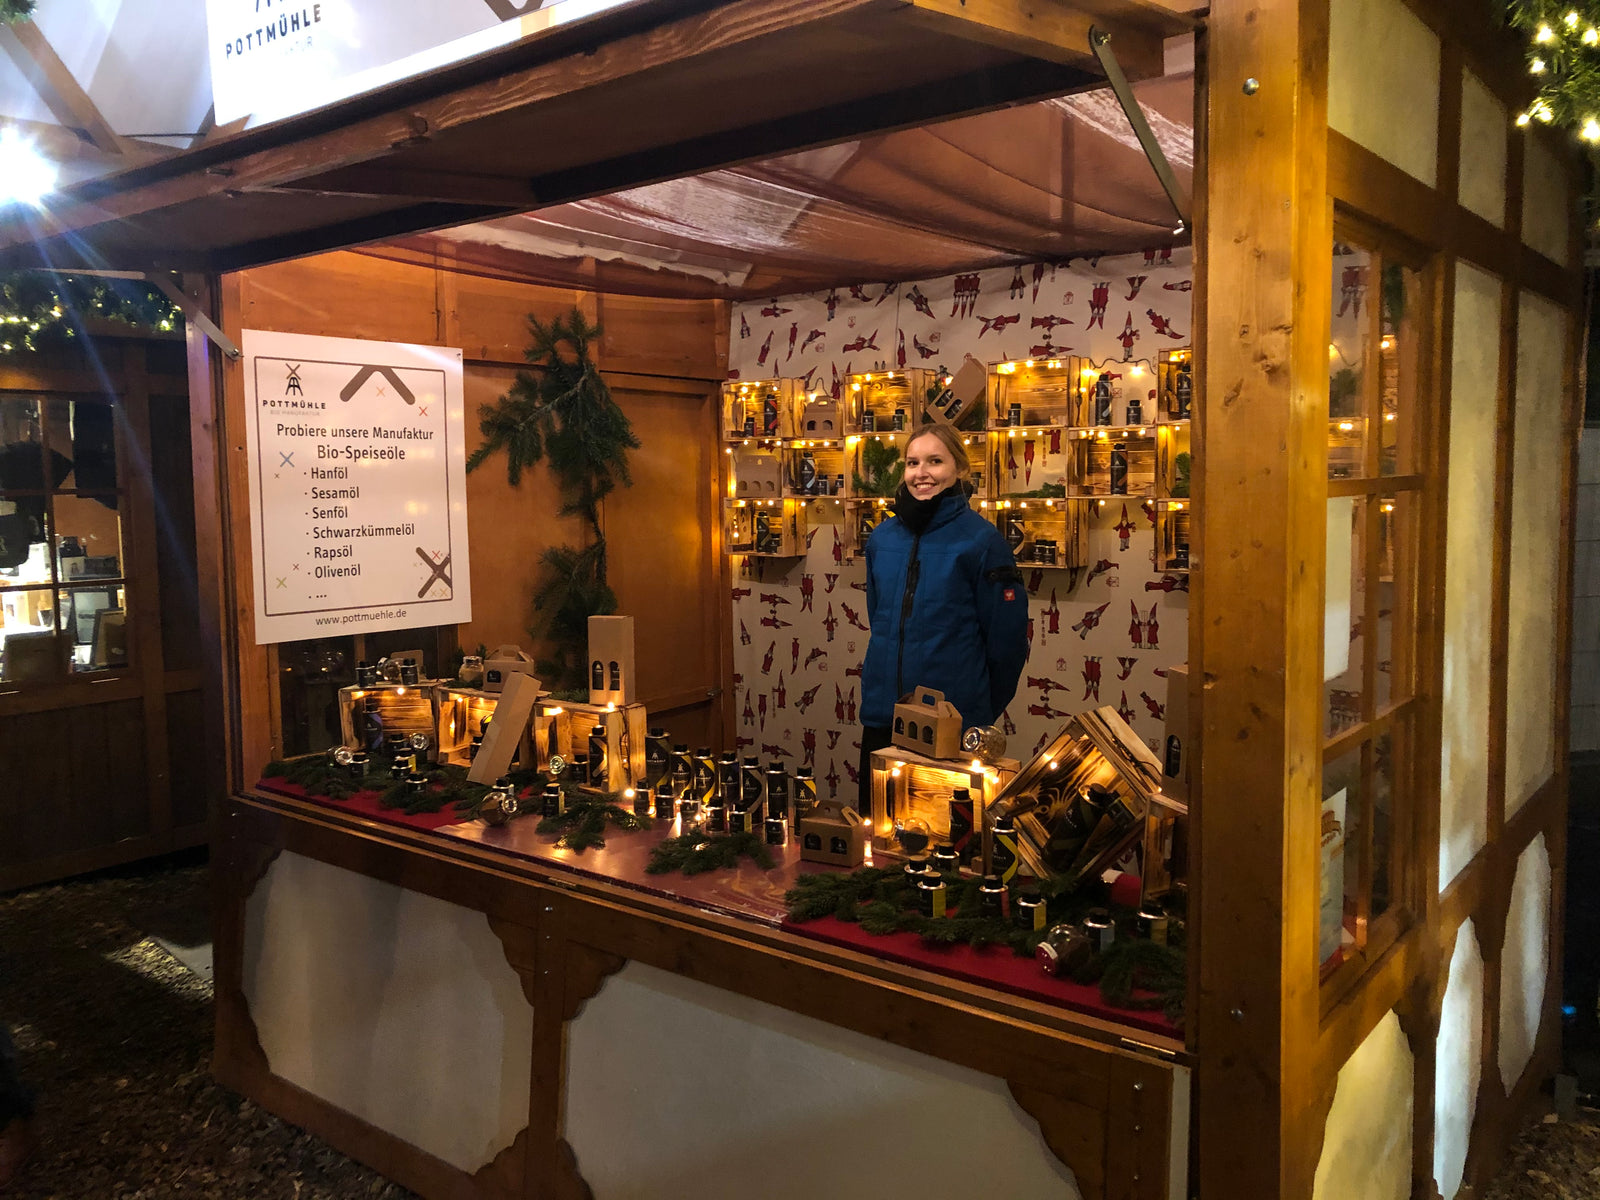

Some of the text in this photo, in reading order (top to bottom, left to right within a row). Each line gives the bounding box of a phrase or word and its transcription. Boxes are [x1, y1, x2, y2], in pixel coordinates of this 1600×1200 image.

[226, 3, 321, 58] POTTMÜHLE
[262, 399, 326, 410] POTTMÜHLE
[276, 424, 434, 440] Probiere unsere Manufaktur
[317, 444, 406, 462] Bio-Speiseöle
[311, 466, 348, 480] Hanföl
[311, 486, 360, 500] Sesamöl
[312, 506, 348, 520] Senföl
[312, 523, 415, 540] Schwarzkümmelöl
[314, 545, 353, 560] Rapsöl
[314, 563, 361, 579] Olivenöl
[315, 608, 407, 626] www.pottmuehle.de
